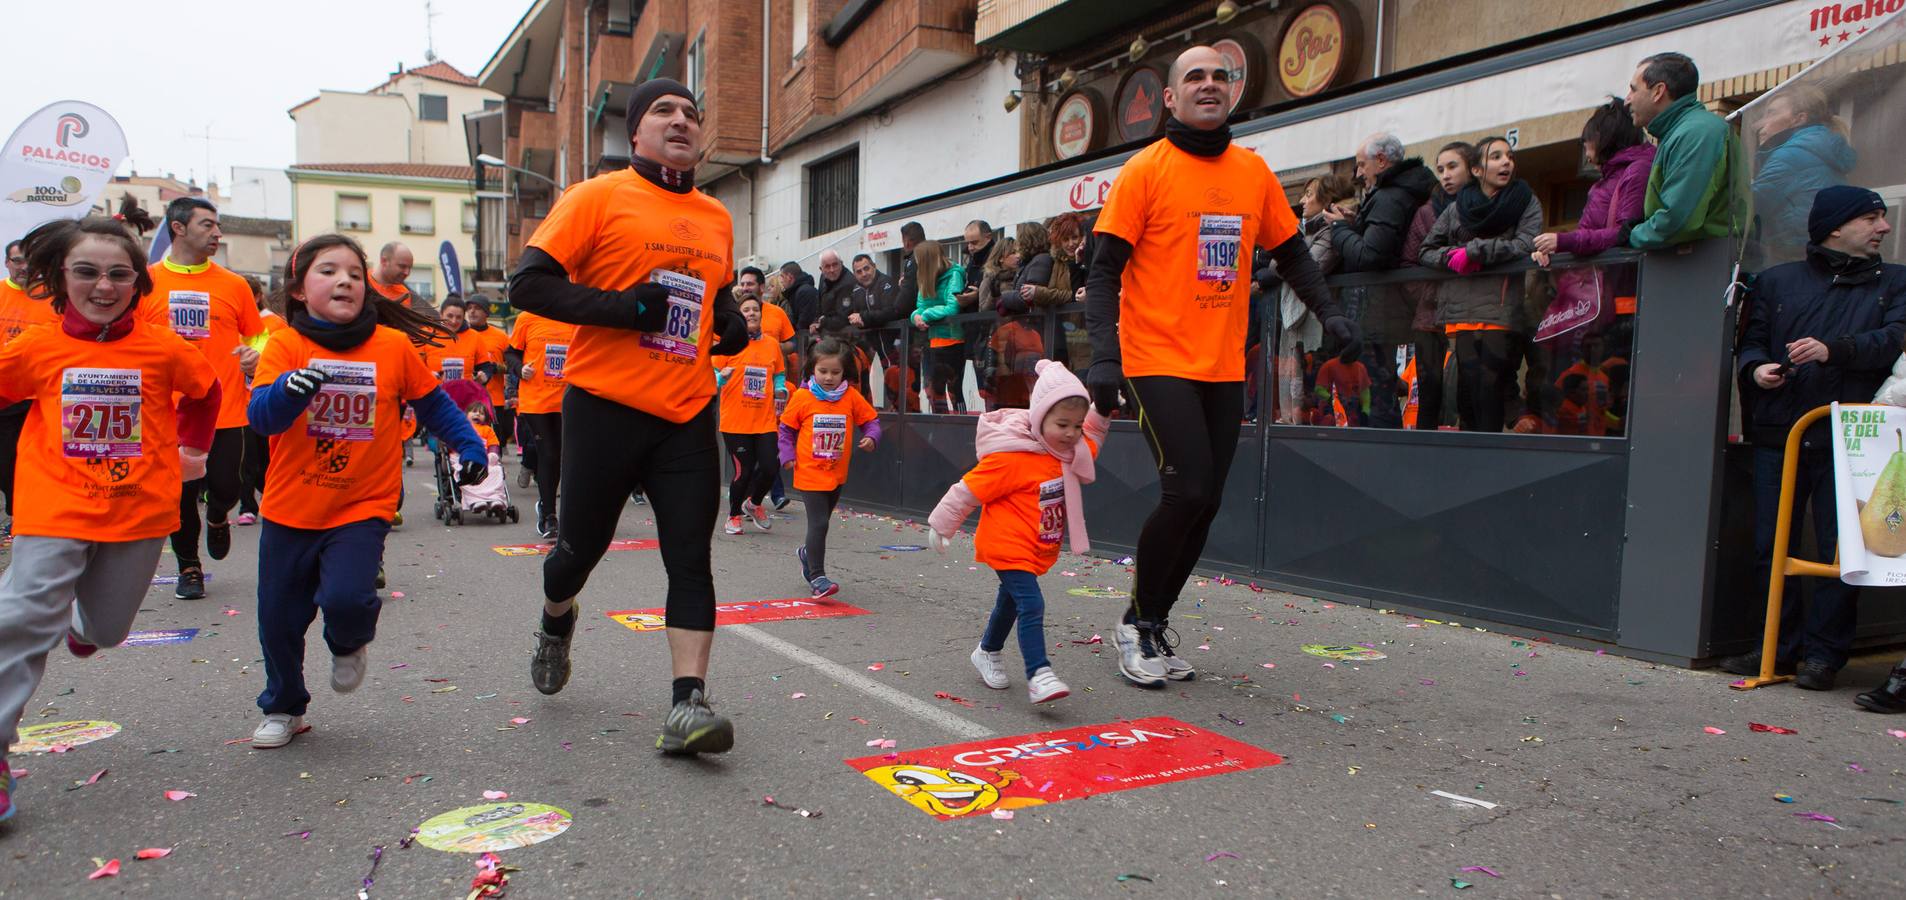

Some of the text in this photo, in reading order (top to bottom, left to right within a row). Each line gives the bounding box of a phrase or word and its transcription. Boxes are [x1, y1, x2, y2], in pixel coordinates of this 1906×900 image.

[22, 145, 110, 169] PALACIOS
[27, 194, 67, 202] natural
[651, 242, 665, 251] SAN
[666, 243, 695, 256] SILVESTRE
[1204, 241, 1236, 267] 1198
[174, 308, 205, 328] 1090
[667, 305, 692, 338] 83
[77, 373, 139, 381] AYUNTAMIENTO
[314, 392, 370, 426] 299
[1841, 410, 1886, 424] AS DEL
[72, 404, 133, 440] 275
[1844, 424, 1880, 437] E DEL
[819, 432, 841, 450] 172
[953, 728, 1176, 767] GREFUSA
